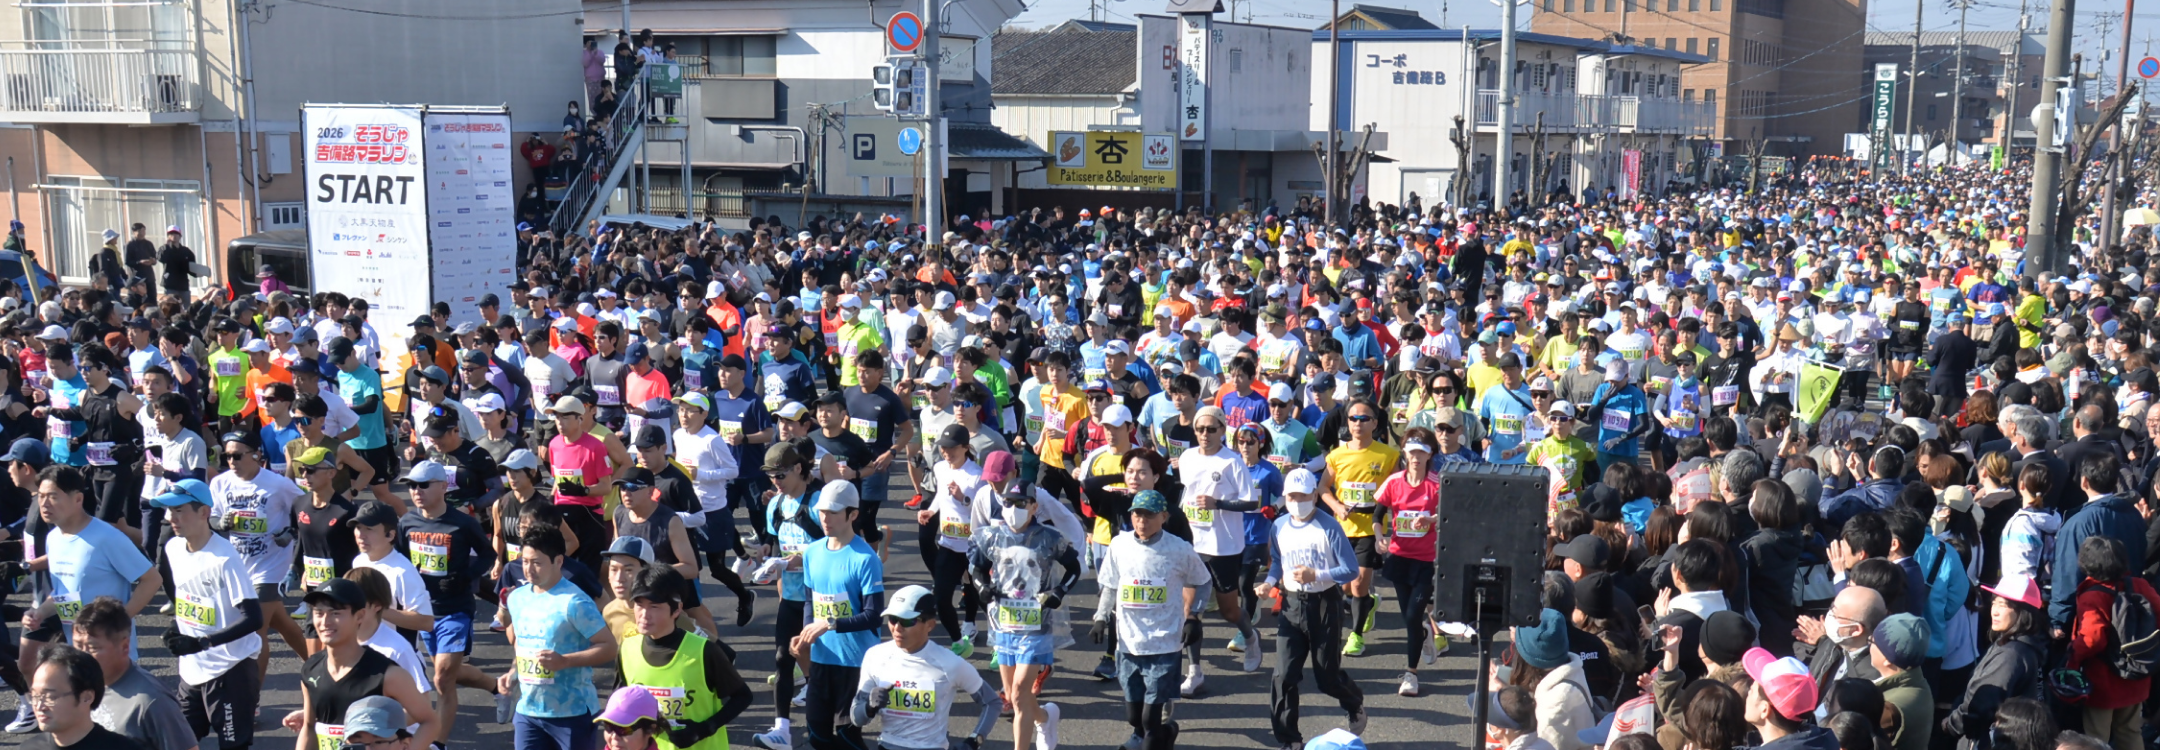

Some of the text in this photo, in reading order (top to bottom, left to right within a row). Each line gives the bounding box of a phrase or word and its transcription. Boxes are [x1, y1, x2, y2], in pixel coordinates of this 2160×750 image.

[1366, 53, 1407, 68] コーポ
[1186, 104, 1199, 120] 杏
[317, 124, 409, 143] 2026 そうじゃ
[1095, 135, 1129, 164] 杏
[317, 173, 415, 205] START
[1122, 587, 1164, 601] B1122
[177, 602, 211, 622] B2421
[1001, 609, 1038, 623] B1373
